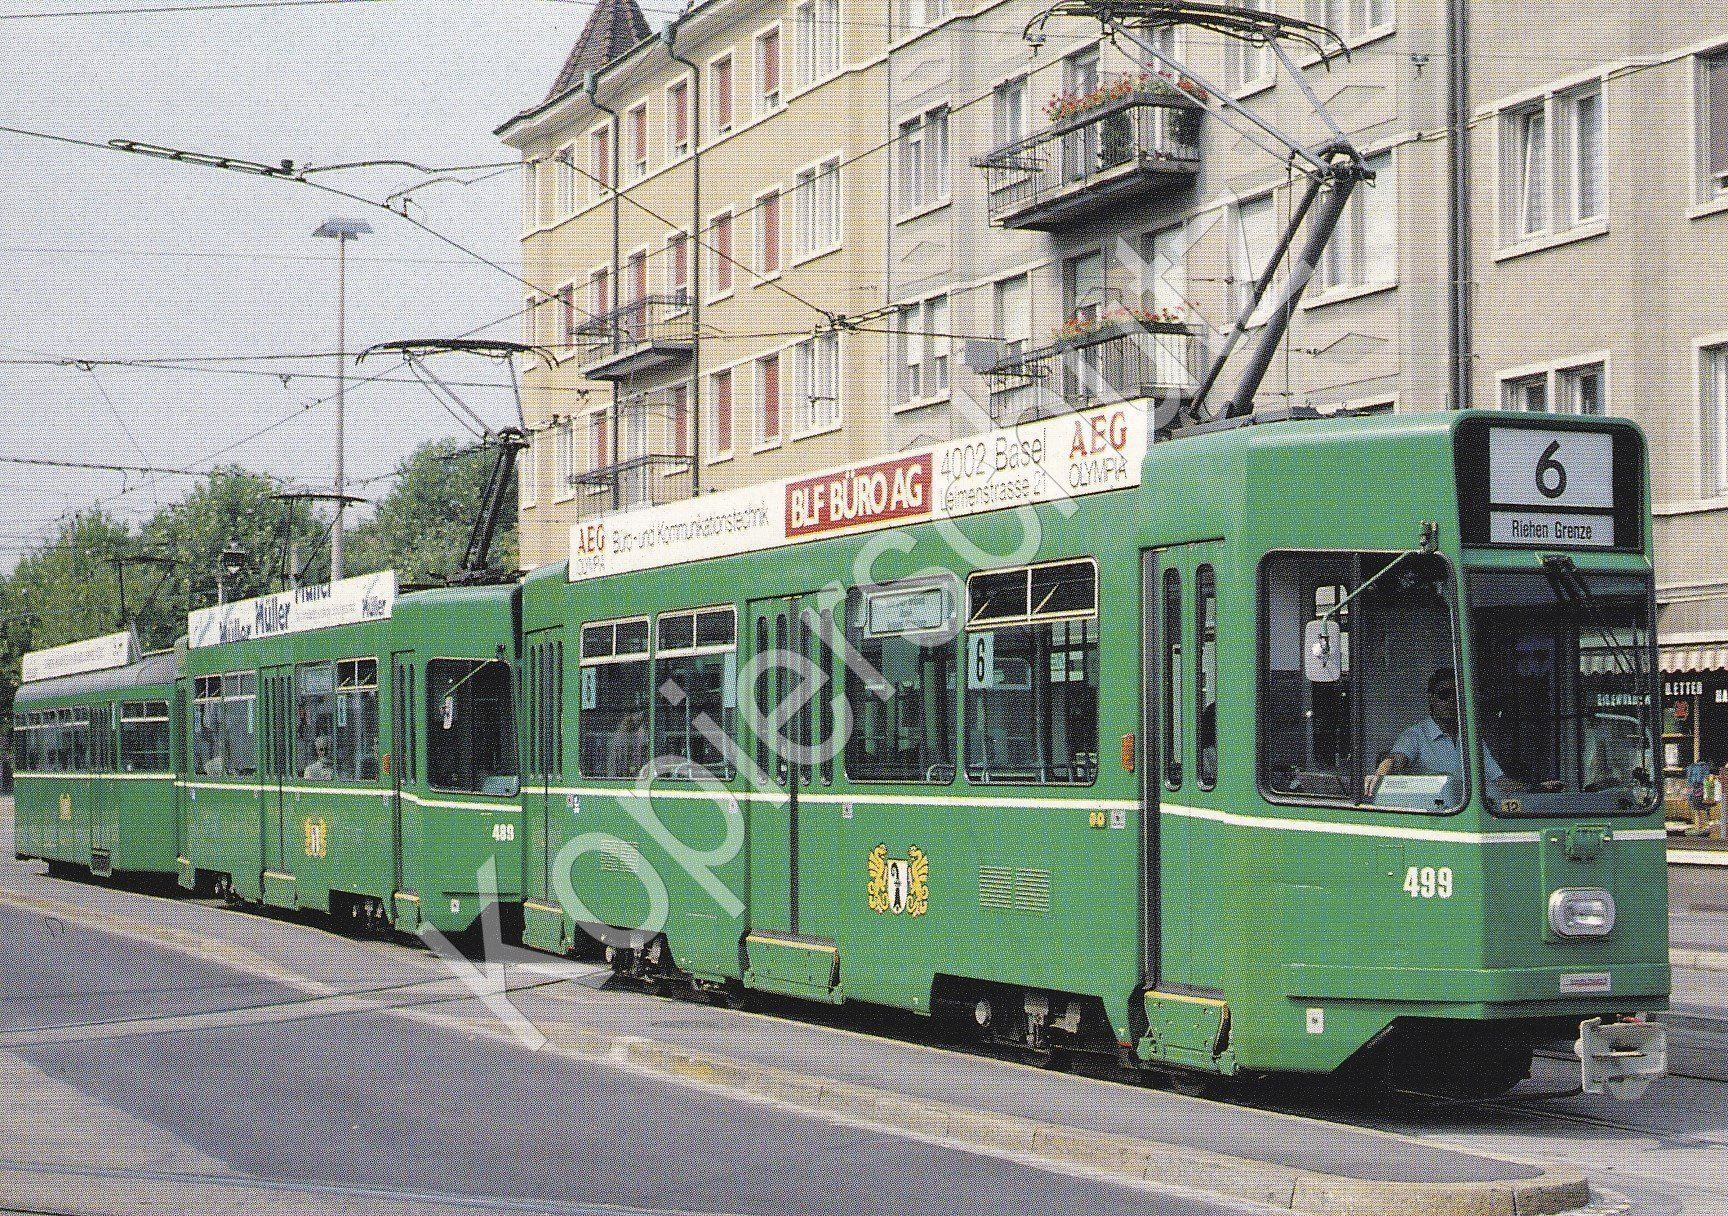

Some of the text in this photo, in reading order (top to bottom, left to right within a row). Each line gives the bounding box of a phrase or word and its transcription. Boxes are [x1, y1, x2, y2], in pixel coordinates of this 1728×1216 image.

[940, 427, 1047, 483] 4002 Basel
[1069, 411, 1128, 460] AEG
[1068, 457, 1128, 488] OLYMPIA
[1535, 440, 1567, 498] 6
[790, 463, 923, 529] BLF BÜRO AG
[578, 523, 605, 553] AEG
[1512, 520, 1592, 539] Riehen Grenze
[256, 596, 291, 635] Müller
[976, 637, 985, 683] 6
[1403, 866, 1453, 899] 499
